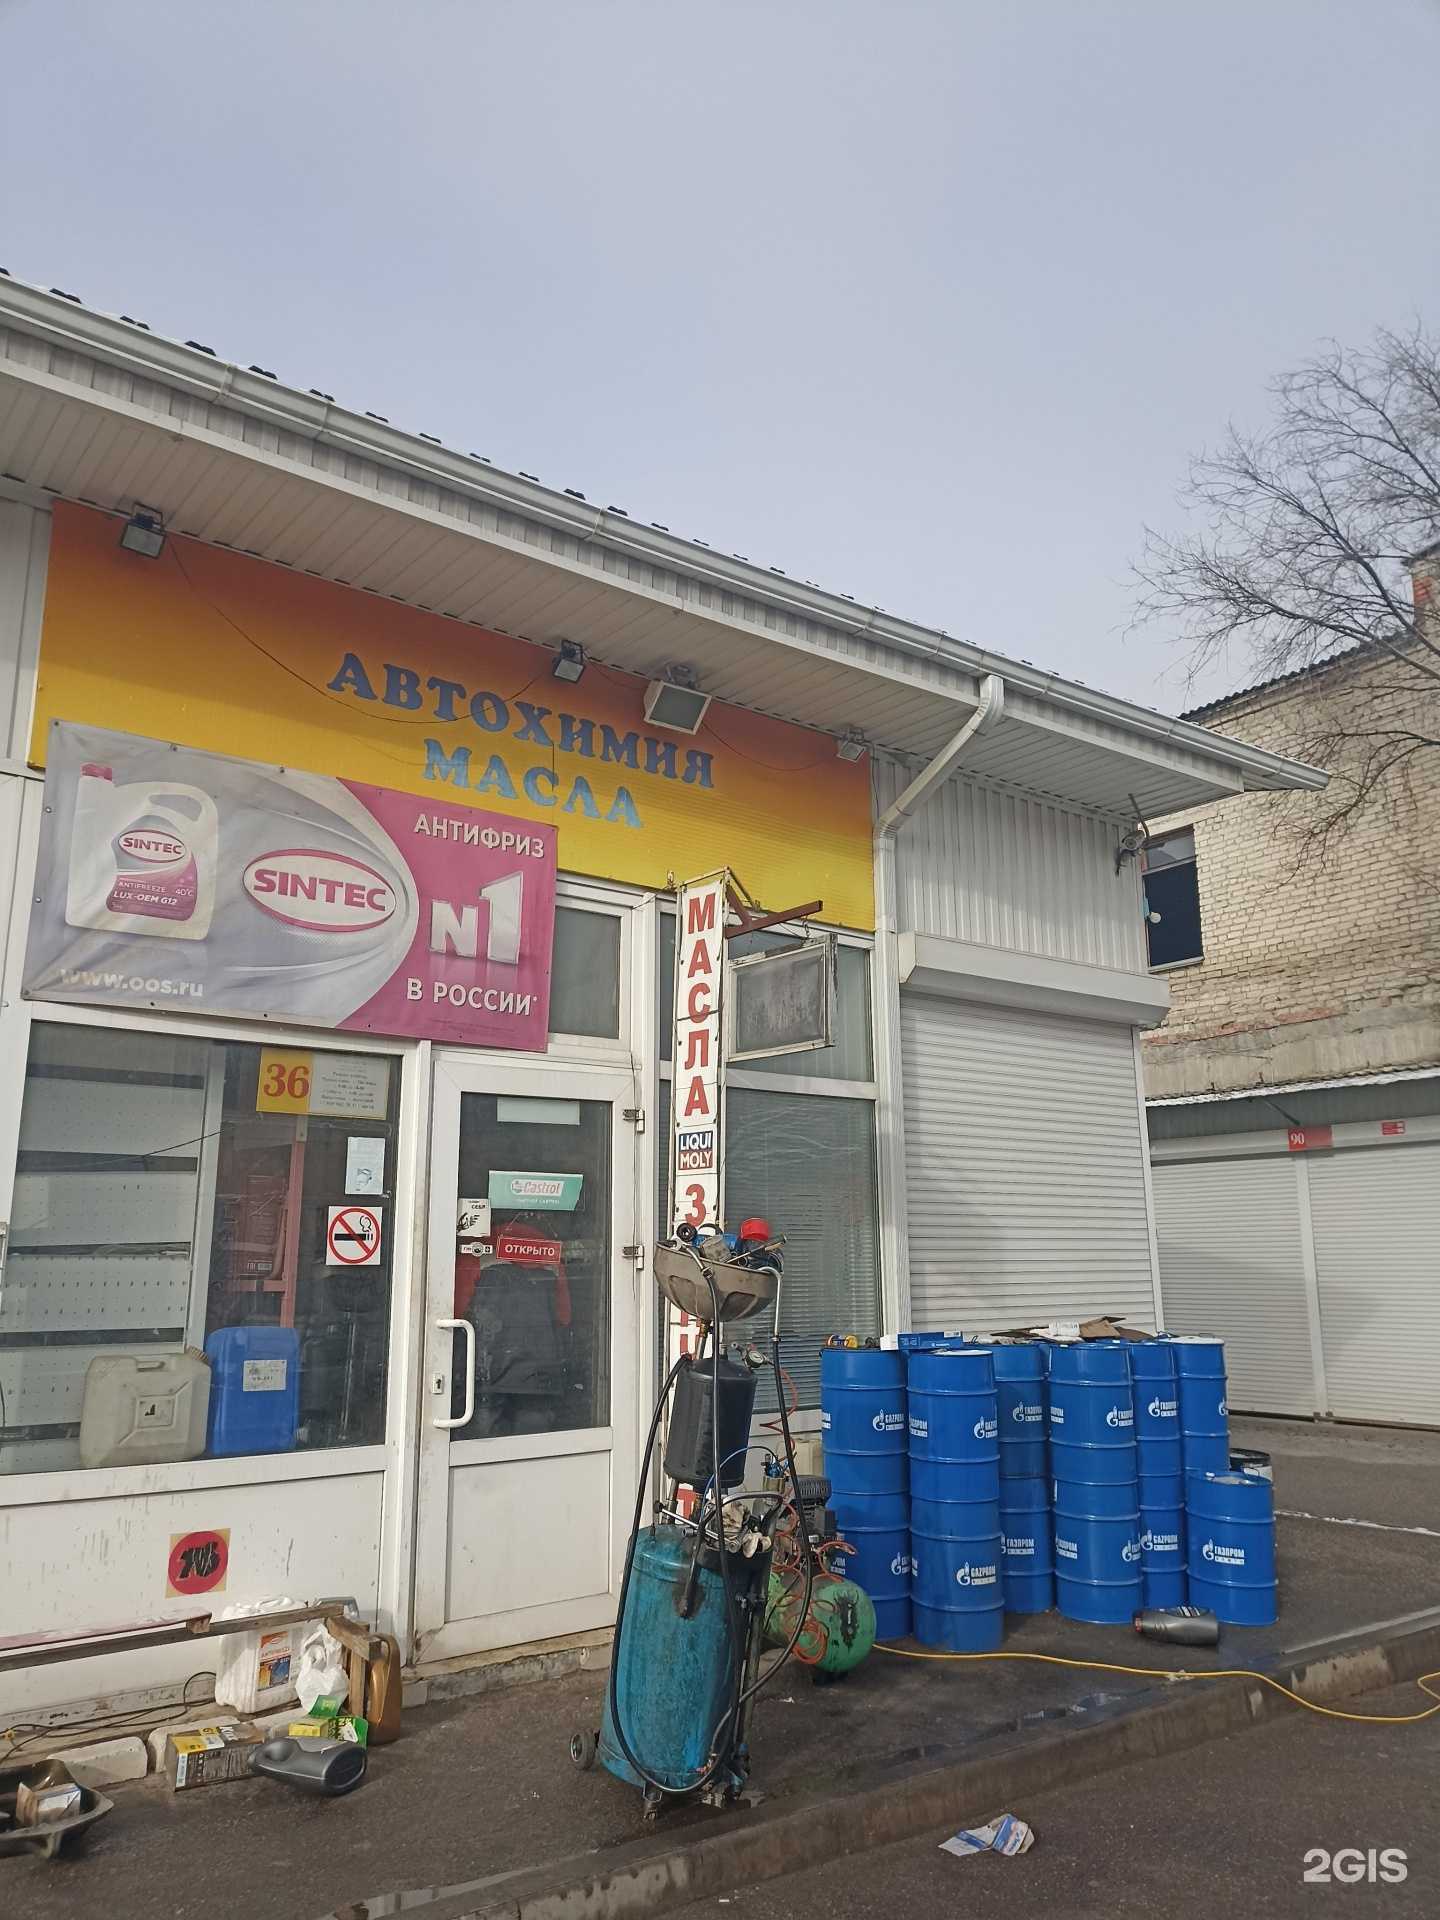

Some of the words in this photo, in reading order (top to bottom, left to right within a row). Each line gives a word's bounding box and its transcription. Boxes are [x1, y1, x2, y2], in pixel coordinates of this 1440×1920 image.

[327, 652, 714, 788] АВТОХИМИЯ
[422, 738, 644, 830] МАСЛА
[414, 813, 545, 858] АНТИФРИЗ
[123, 837, 182, 855] SINTEC
[118, 881, 166, 893] ANTIFREEZE
[253, 868, 387, 913] SINTEC
[113, 890, 158, 903] LUX-OEM
[160, 896, 177, 906] G12
[60, 968, 203, 997] www.oos.ru
[407, 977, 423, 1001] В
[685, 893, 714, 1117] МАСЛА
[263, 1063, 310, 1099] 36
[680, 1132, 712, 1151] LIQUI
[1291, 1132, 1304, 1144] 90
[680, 1151, 712, 1169] MOLY
[524, 1182, 561, 1194] Castrol
[505, 1244, 555, 1257] ОТКРЫТО
[1007, 1538, 1034, 1547] ГАЗПРОМ
[1215, 1545, 1245, 1557] ГАЗПРОМ
